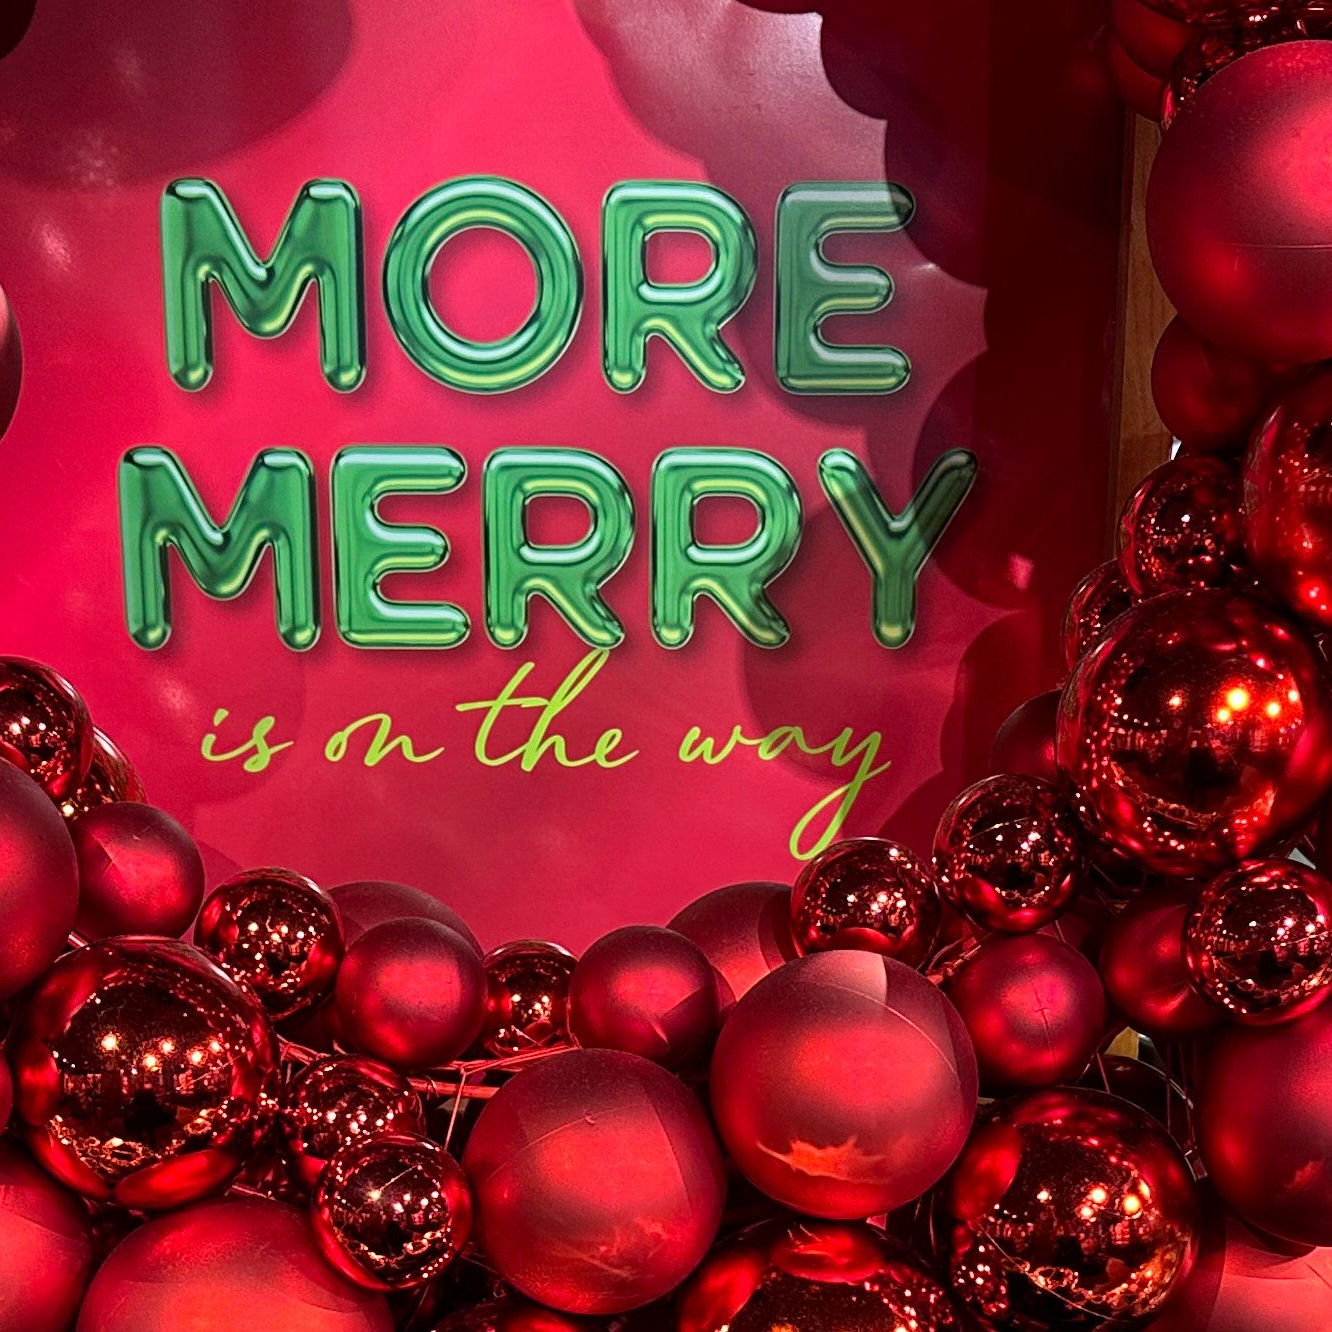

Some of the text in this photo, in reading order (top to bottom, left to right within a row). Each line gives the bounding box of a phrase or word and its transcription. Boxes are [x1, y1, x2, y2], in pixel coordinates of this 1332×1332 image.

[159, 174, 915, 395] MORE
[118, 444, 979, 652] MERRY
[200, 648, 892, 861] is on the way
